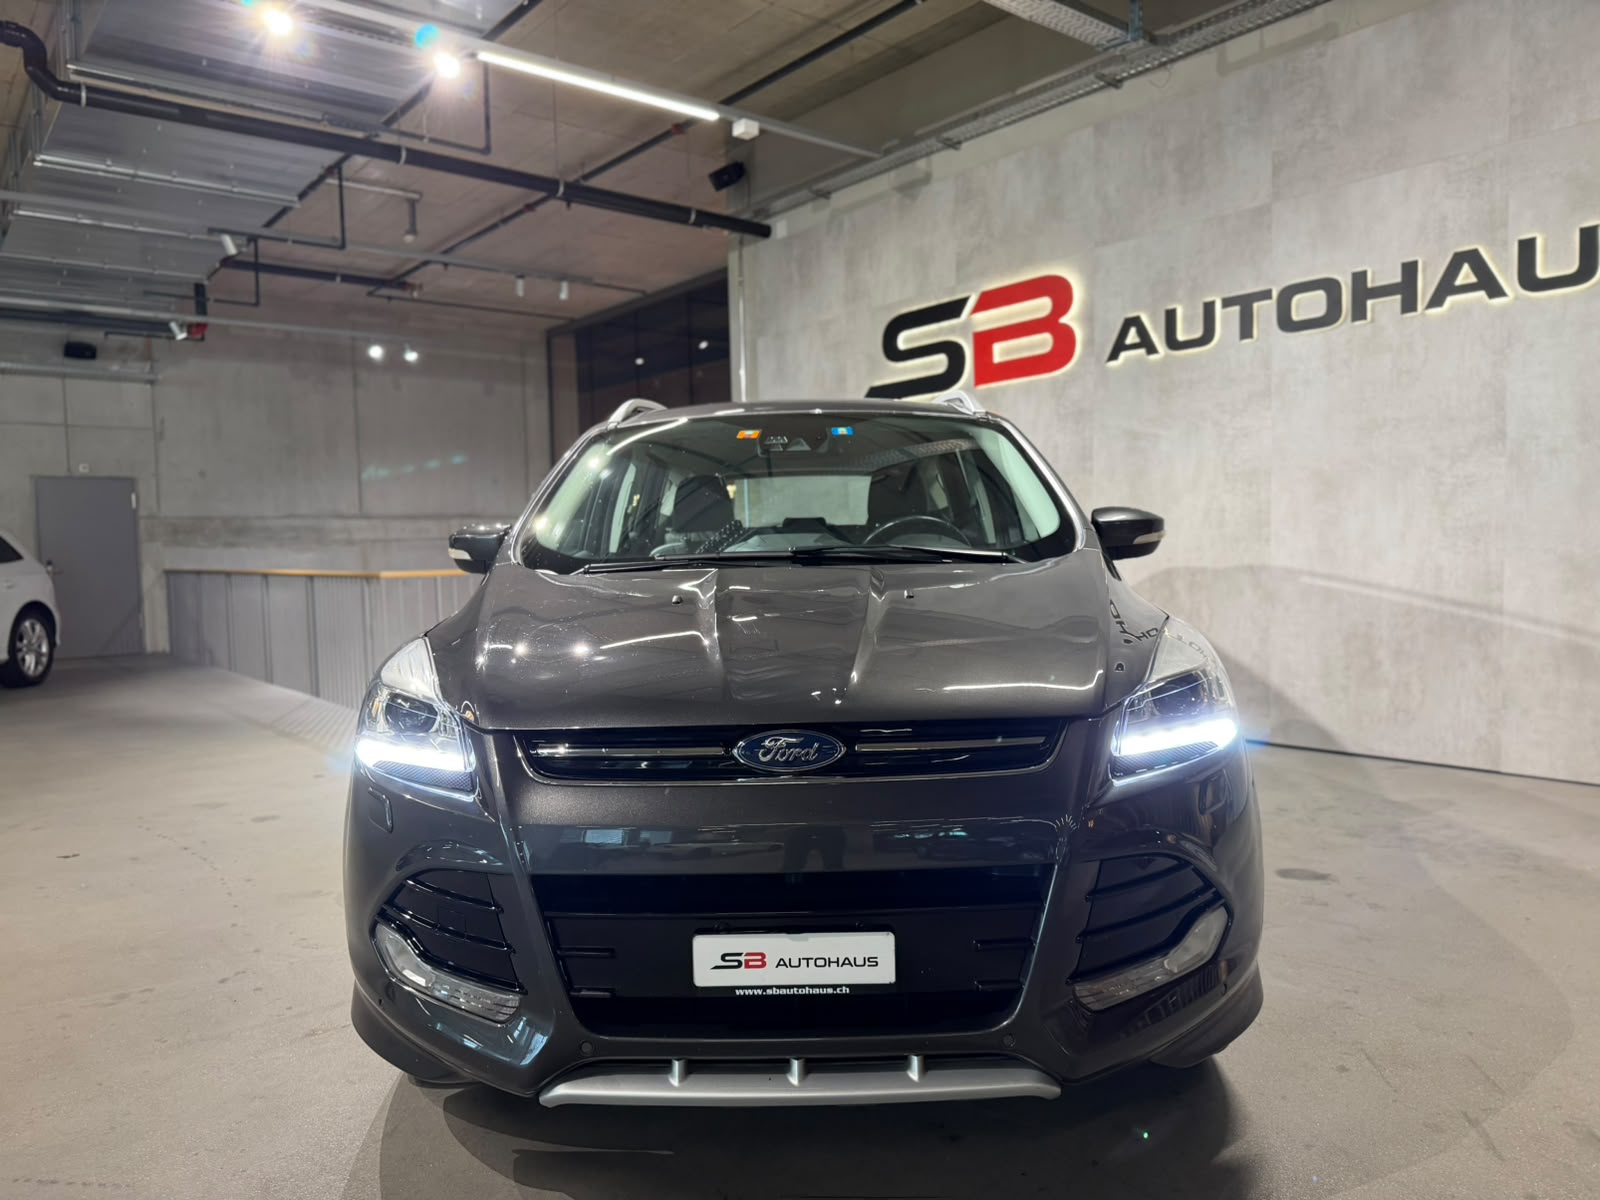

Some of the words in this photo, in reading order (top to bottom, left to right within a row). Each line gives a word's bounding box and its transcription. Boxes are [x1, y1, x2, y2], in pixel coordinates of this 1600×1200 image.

[865, 274, 1076, 400] SB
[1105, 224, 1600, 363] AUTOHAU
[758, 736, 820, 762] Ford
[710, 952, 767, 970] SB
[775, 956, 879, 968] AUTOHAUS
[735, 986, 850, 996] www.sbautohaus.ch
